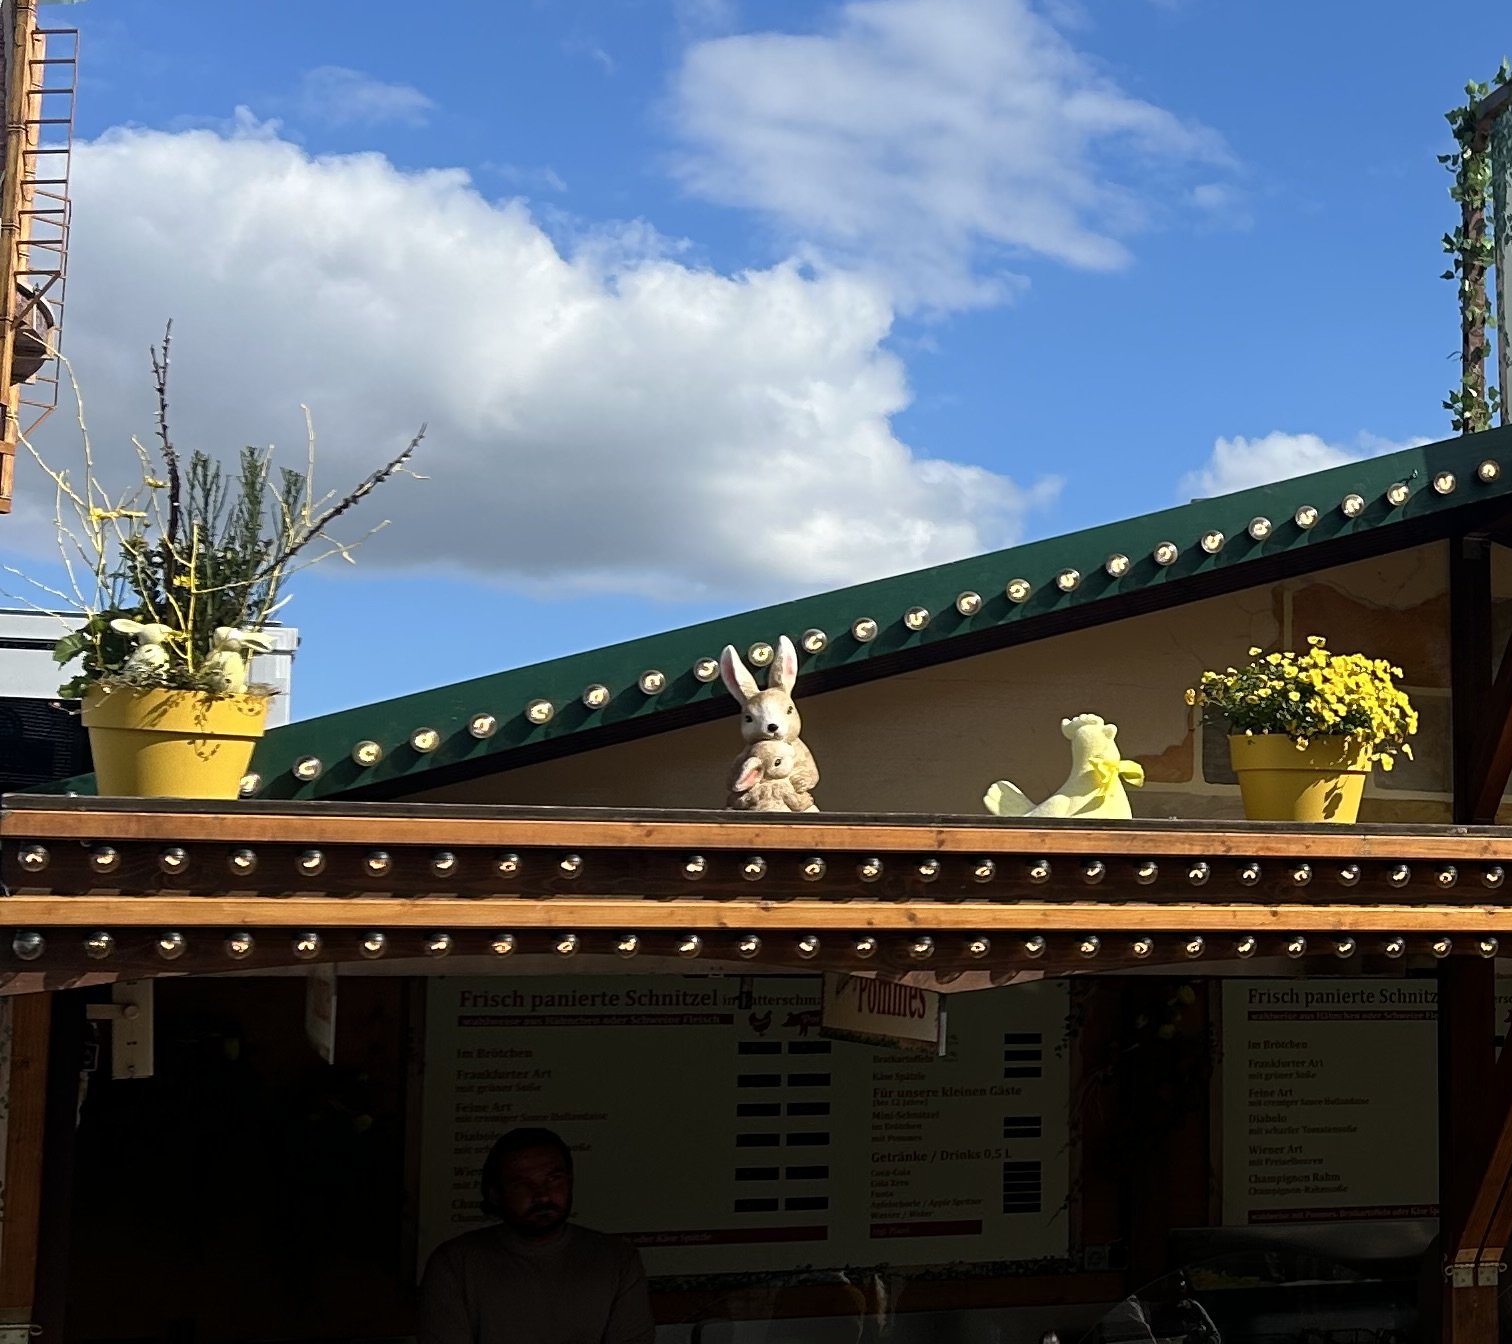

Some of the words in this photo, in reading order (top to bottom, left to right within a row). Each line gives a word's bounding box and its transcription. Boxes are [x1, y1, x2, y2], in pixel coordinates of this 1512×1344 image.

[459, 989, 525, 1008] Frisch
[530, 989, 620, 1012] panierte
[624, 988, 718, 1008] Schnitzel
[1248, 988, 1299, 1004] Frisch
[1305, 988, 1375, 1007] panierte
[1379, 987, 1438, 1004] Schnitz
[532, 1068, 552, 1078] Art
[873, 1087, 895, 1098] Für
[899, 1088, 939, 1098] unsere
[942, 1086, 986, 1097] kleinen
[989, 1085, 1022, 1097] Gäste
[492, 1102, 511, 1112] Art
[871, 1150, 928, 1163] Getränke
[940, 1149, 981, 1161] Drinks
